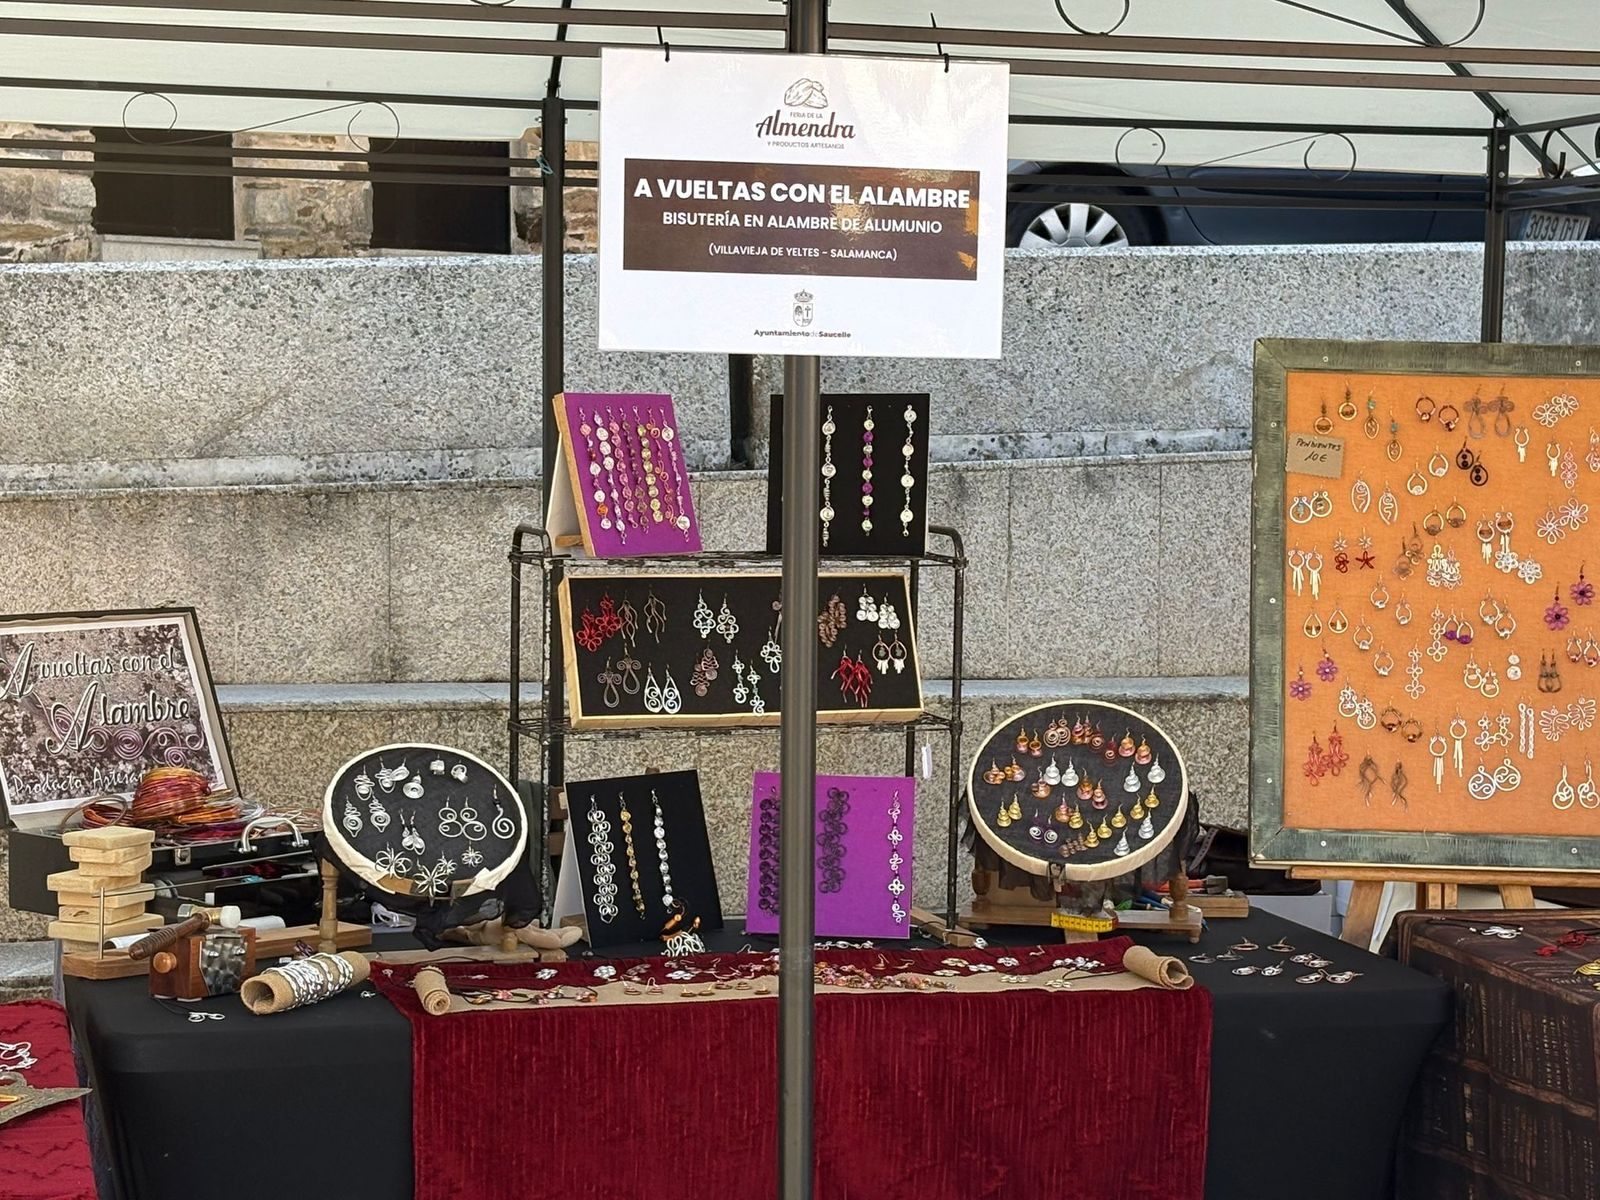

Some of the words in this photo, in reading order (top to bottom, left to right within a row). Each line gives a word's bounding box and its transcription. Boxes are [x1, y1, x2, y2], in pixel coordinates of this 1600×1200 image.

[756, 109, 856, 139] Almendra
[790, 111, 806, 119] FERIA
[810, 142, 845, 150] ARTESANOS
[634, 178, 653, 198] A
[657, 179, 766, 201] VUELTAS
[770, 183, 825, 203] CON
[830, 185, 855, 205] EL
[858, 186, 970, 209] ALAMBRE
[663, 210, 740, 227] BISUTERÍA
[744, 214, 763, 228] EN
[767, 215, 838, 230] ALAMBRE
[842, 218, 861, 231] DE
[864, 220, 943, 234] ALUMUNIO
[1525, 214, 1559, 240] 3039
[708, 243, 768, 256] (VILLAVIEJA
[770, 247, 784, 256] DE
[786, 247, 820, 257] YELTES
[830, 248, 898, 262] SALAMANCA)
[754, 329, 810, 337] Ayuntamiento
[1296, 438, 1342, 451] PENDIENTES
[0, 641, 35, 699] A
[40, 651, 113, 680] vueltas
[120, 655, 154, 673] con
[159, 645, 178, 671] el
[45, 681, 190, 754] Alambre
[12, 770, 83, 795] Producto
